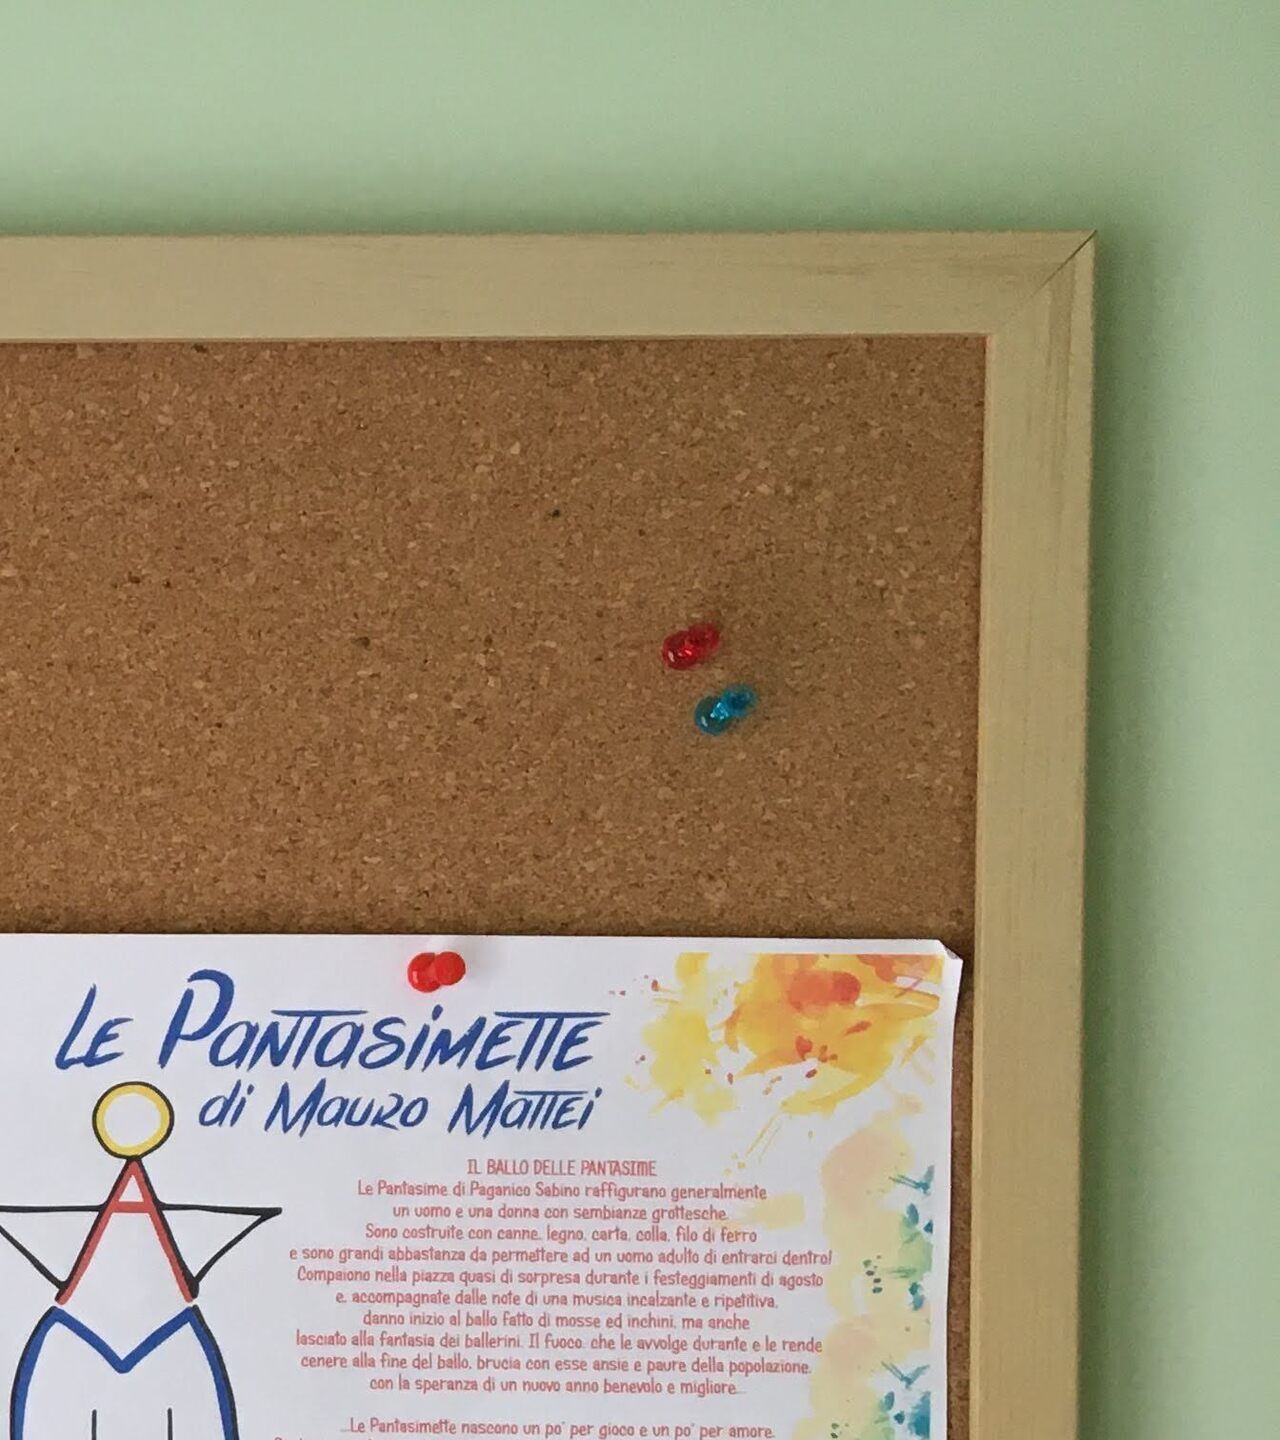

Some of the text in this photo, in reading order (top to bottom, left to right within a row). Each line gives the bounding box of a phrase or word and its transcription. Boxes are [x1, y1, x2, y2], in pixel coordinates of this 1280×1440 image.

[199, 1078, 253, 1127] di
[467, 1159, 657, 1176] IL BALLO DELLE PANTASIME
[358, 1180, 767, 1203] Le Pantasime di Paganico Sabino raffigurano generalmente
